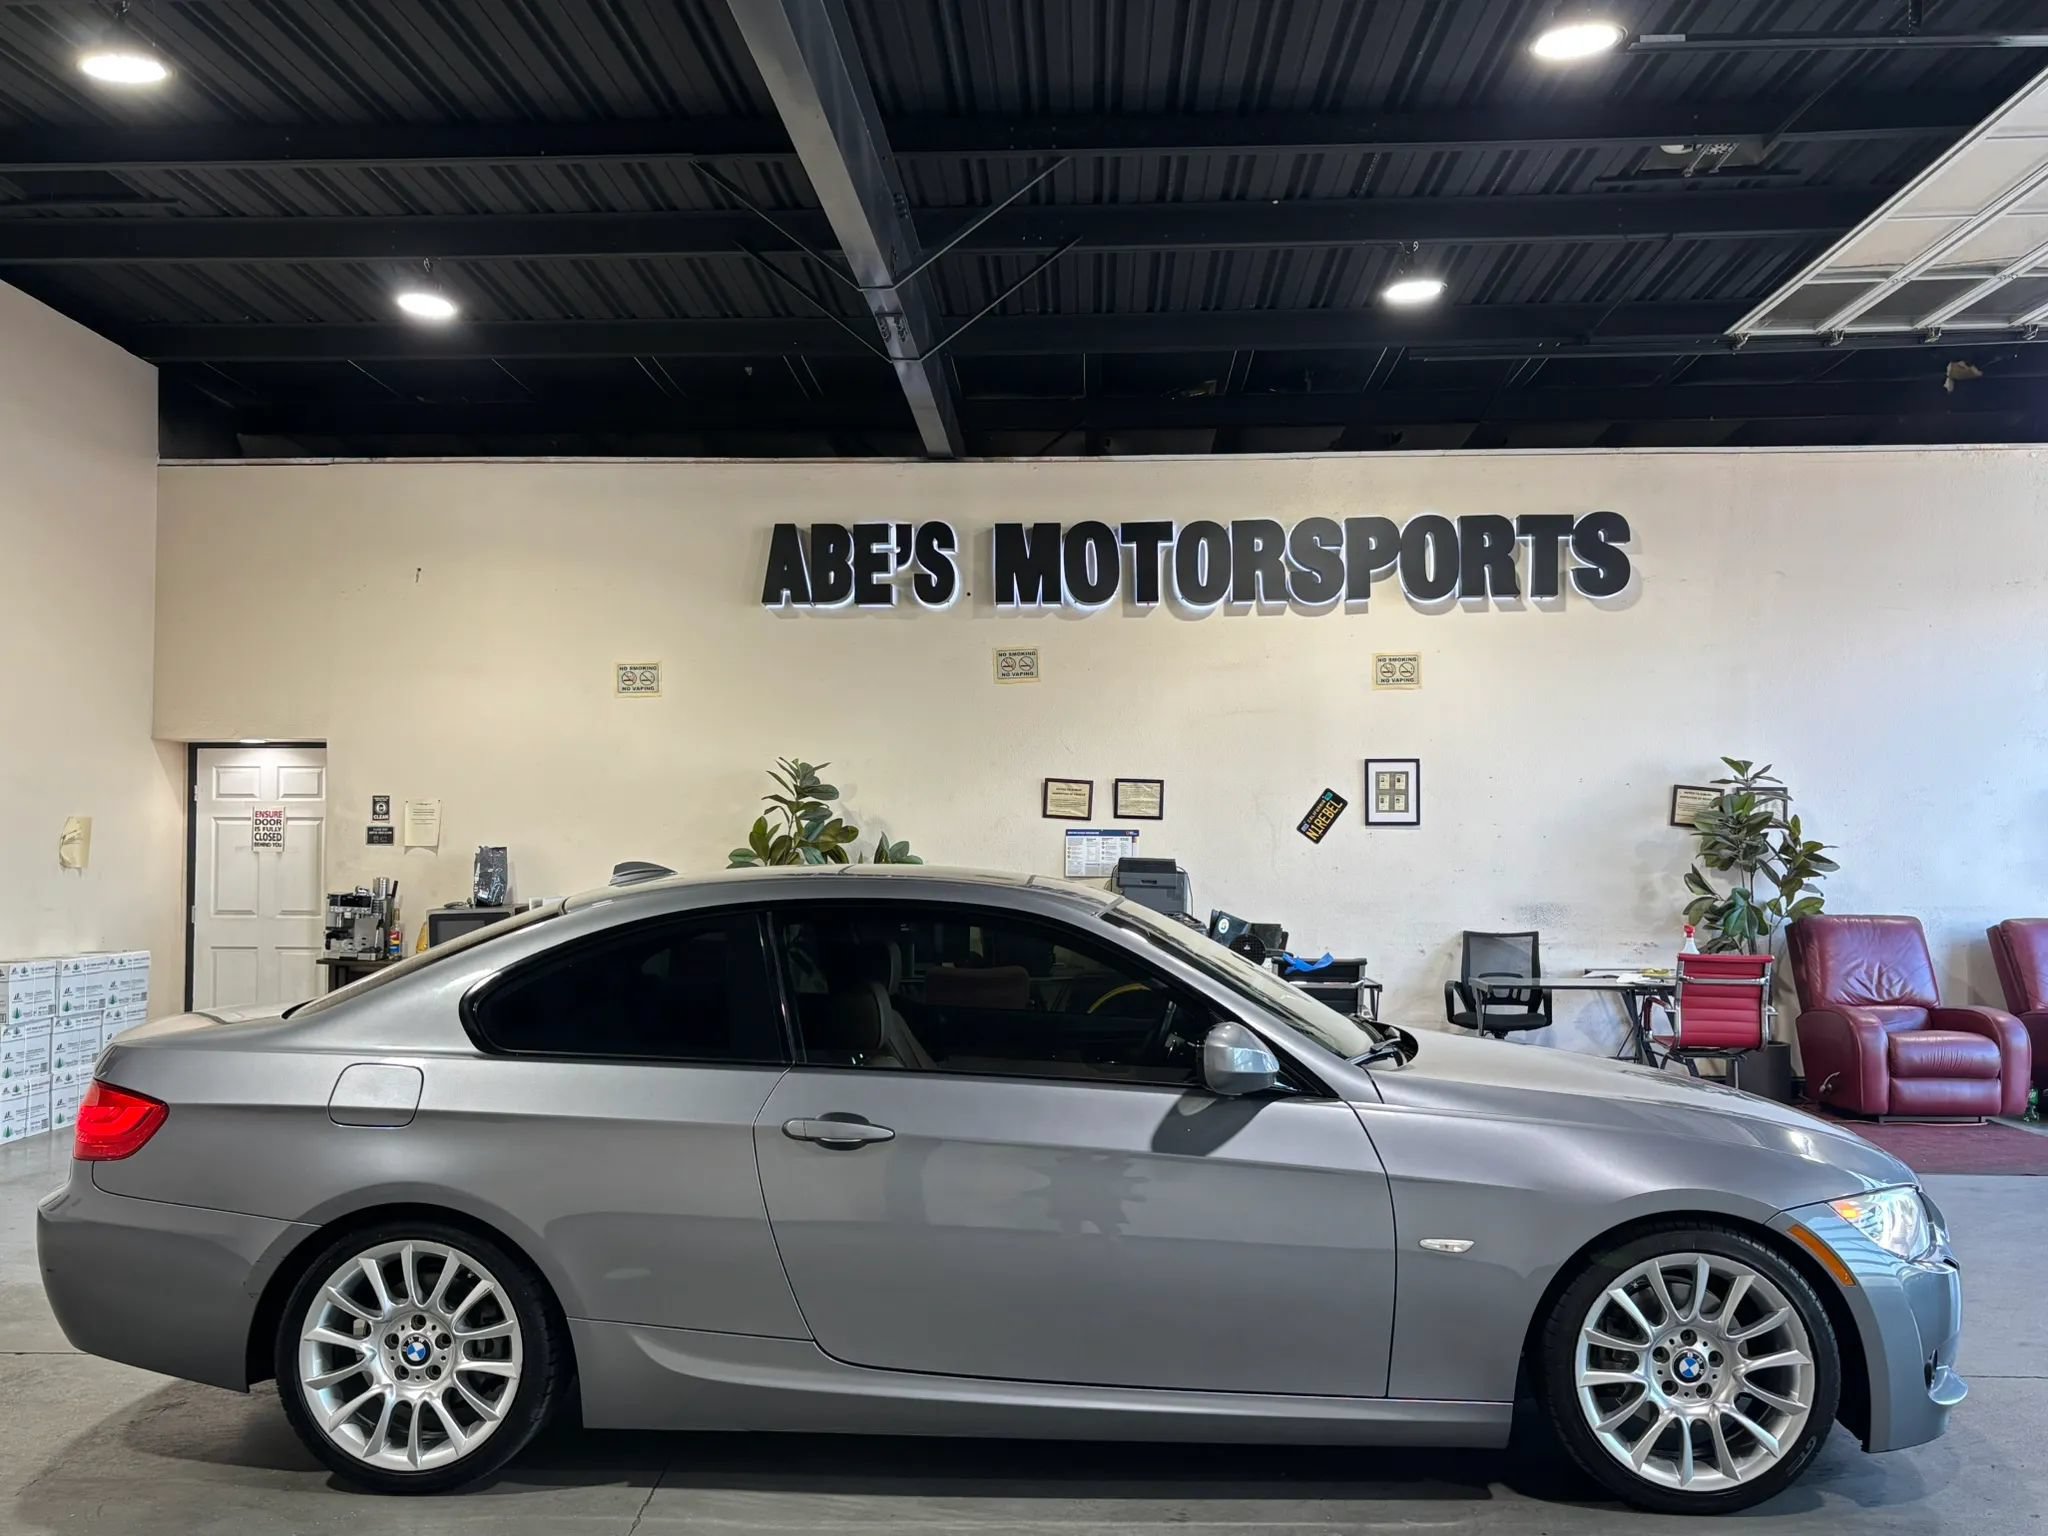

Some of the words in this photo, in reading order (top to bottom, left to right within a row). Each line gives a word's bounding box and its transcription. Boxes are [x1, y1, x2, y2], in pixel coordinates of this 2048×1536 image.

[761, 520, 957, 606] ABE'S
[995, 511, 1631, 608] MOTORSPORTS
[255, 810, 283, 818] ENSURE
[1307, 799, 1326, 823] CALIFORNIA
[254, 818, 282, 826] DOOR
[1306, 800, 1343, 840] N1REBEL
[254, 832, 282, 842] CLOSED
